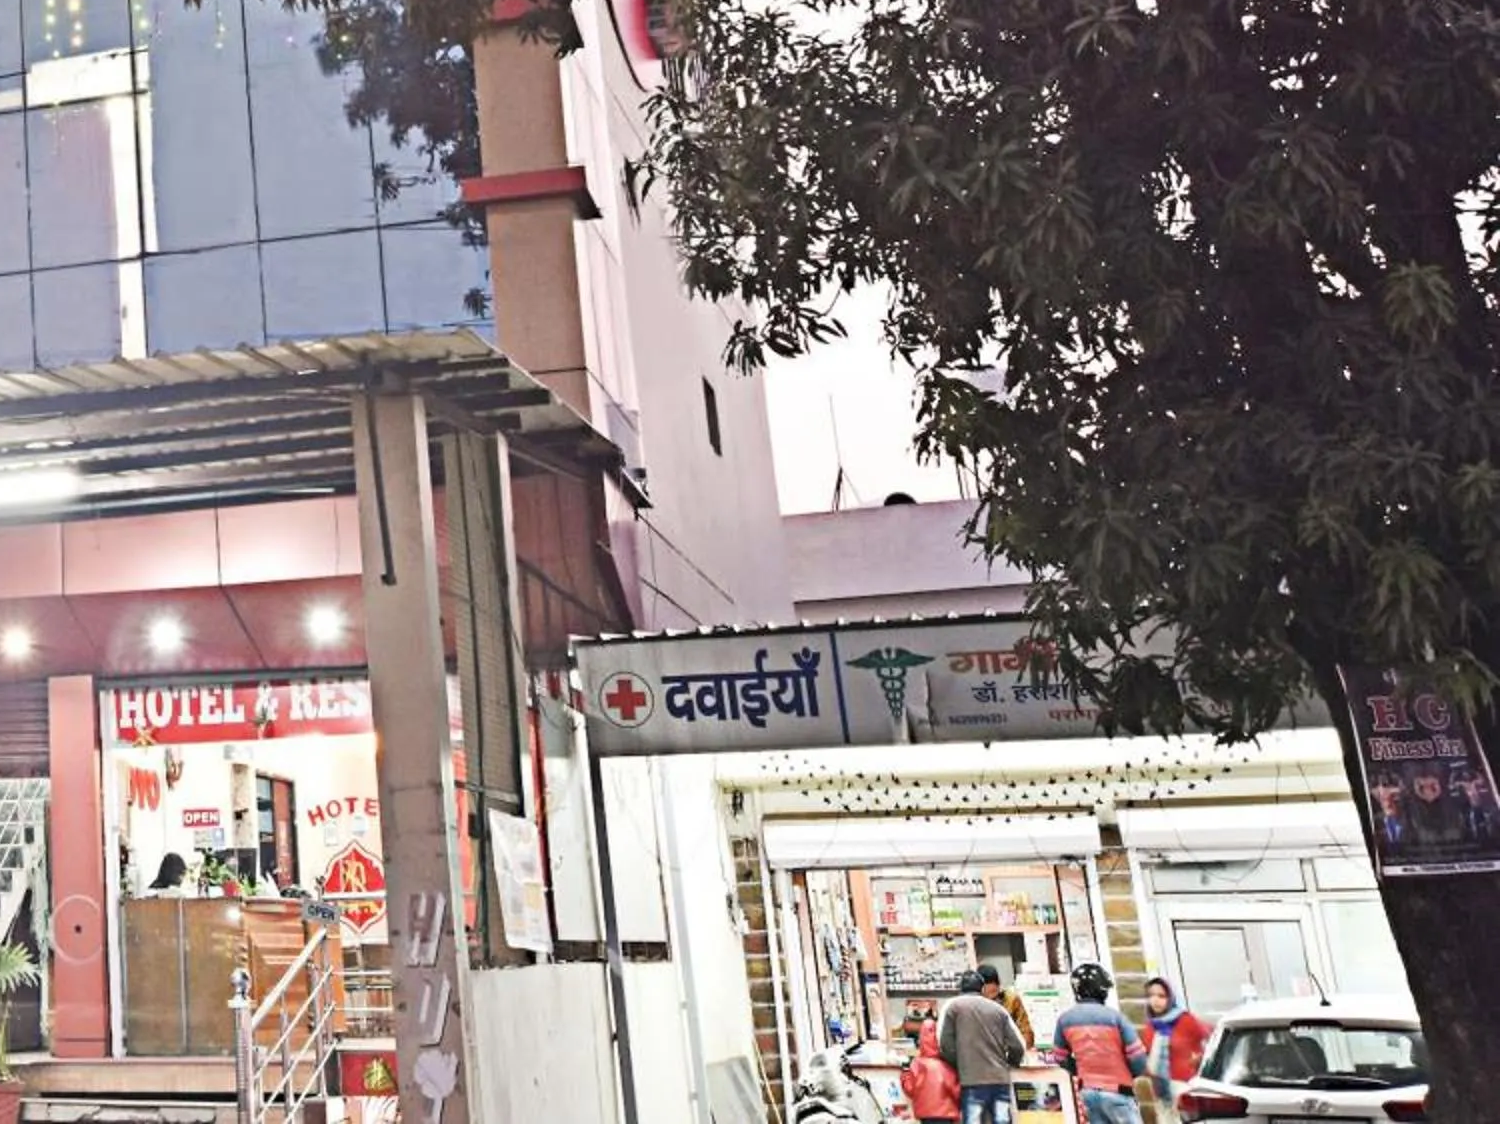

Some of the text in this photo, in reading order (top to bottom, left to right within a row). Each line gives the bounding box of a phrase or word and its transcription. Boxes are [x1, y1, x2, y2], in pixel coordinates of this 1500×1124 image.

[119, 684, 245, 728] HOTEL
[289, 679, 370, 721] RES
[184, 811, 219, 825] OPEN
[307, 904, 336, 923] OPEN
